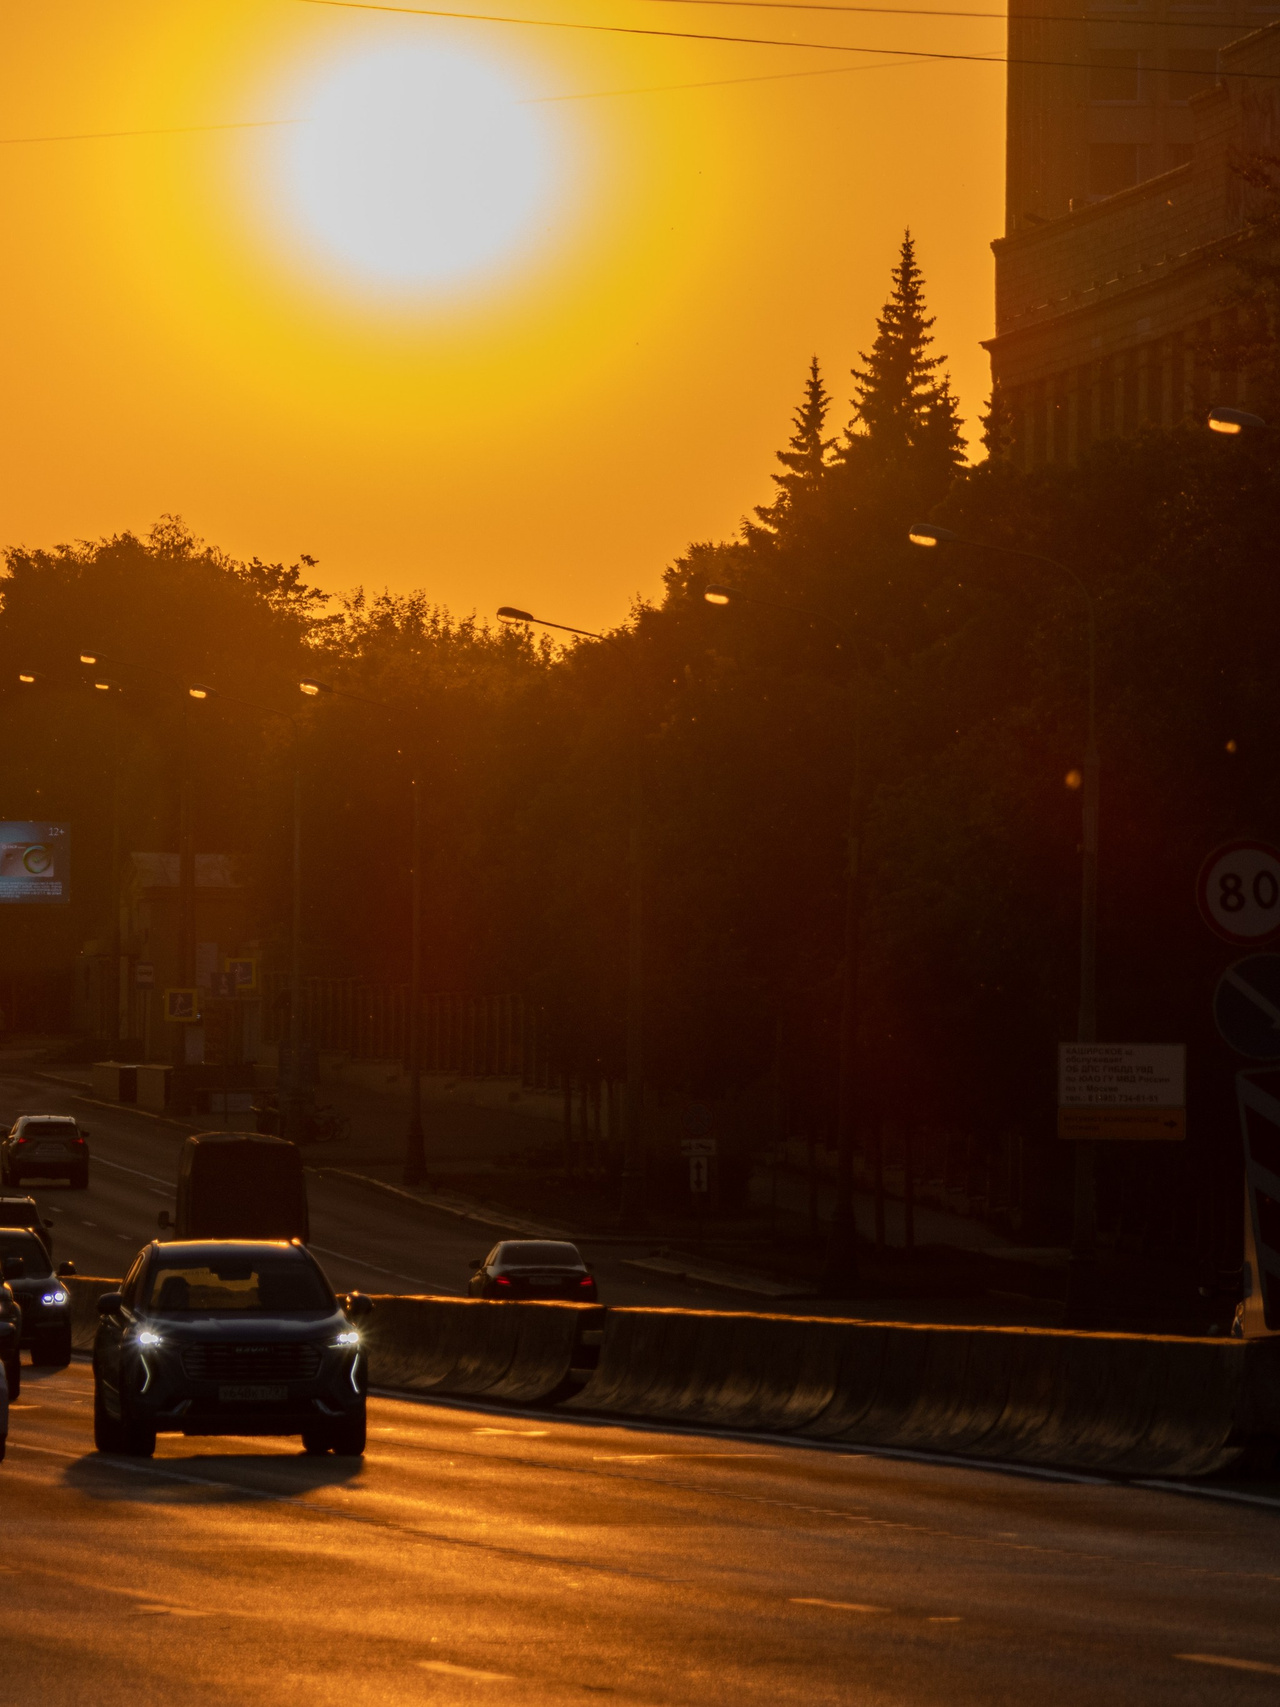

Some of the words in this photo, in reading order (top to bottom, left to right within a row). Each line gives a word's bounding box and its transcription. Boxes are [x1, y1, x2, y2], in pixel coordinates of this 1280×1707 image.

[48, 827, 65, 836] 12+
[1220, 870, 1278, 912] 80
[1065, 1056, 1122, 1064] обслуживает
[1081, 1065, 1100, 1073] ДПС
[1103, 1065, 1133, 1074] ГИБДД
[1116, 1075, 1136, 1083] МВД
